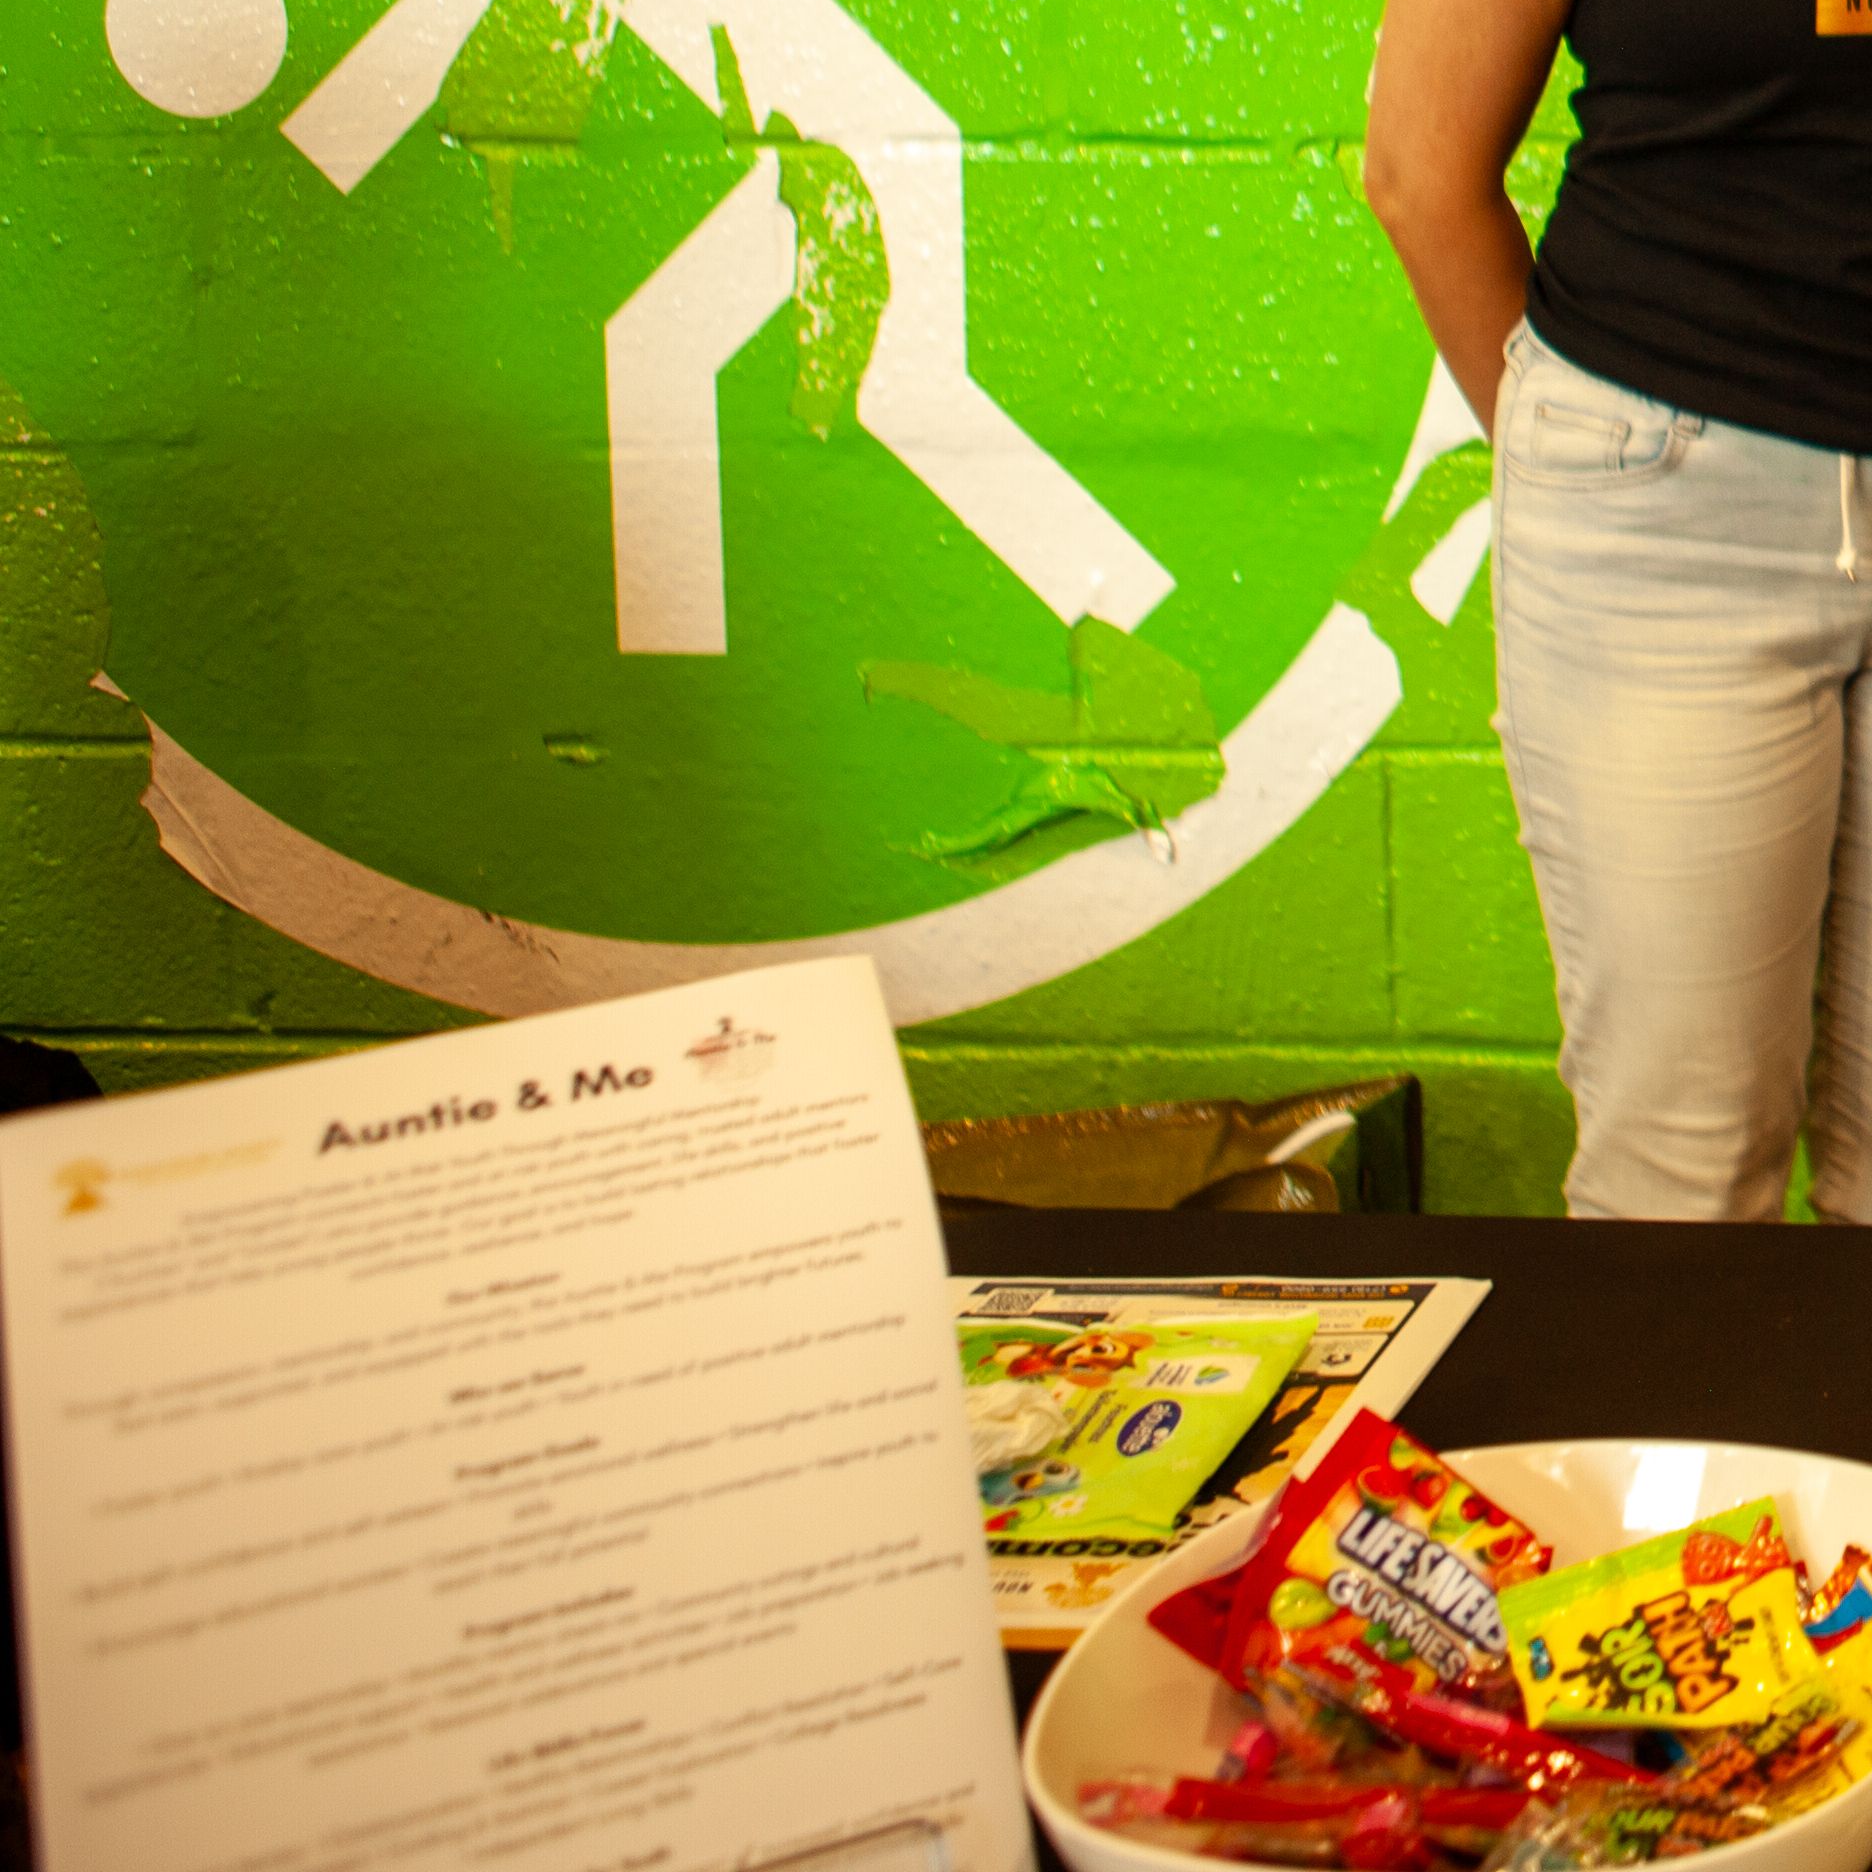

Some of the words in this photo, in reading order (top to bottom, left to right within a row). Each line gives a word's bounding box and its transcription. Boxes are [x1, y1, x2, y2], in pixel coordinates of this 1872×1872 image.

[318, 1094, 497, 1157] Auntie
[517, 1078, 552, 1112] &
[570, 1062, 654, 1102] Me
[1327, 1570, 1468, 1680] GUMMIES
